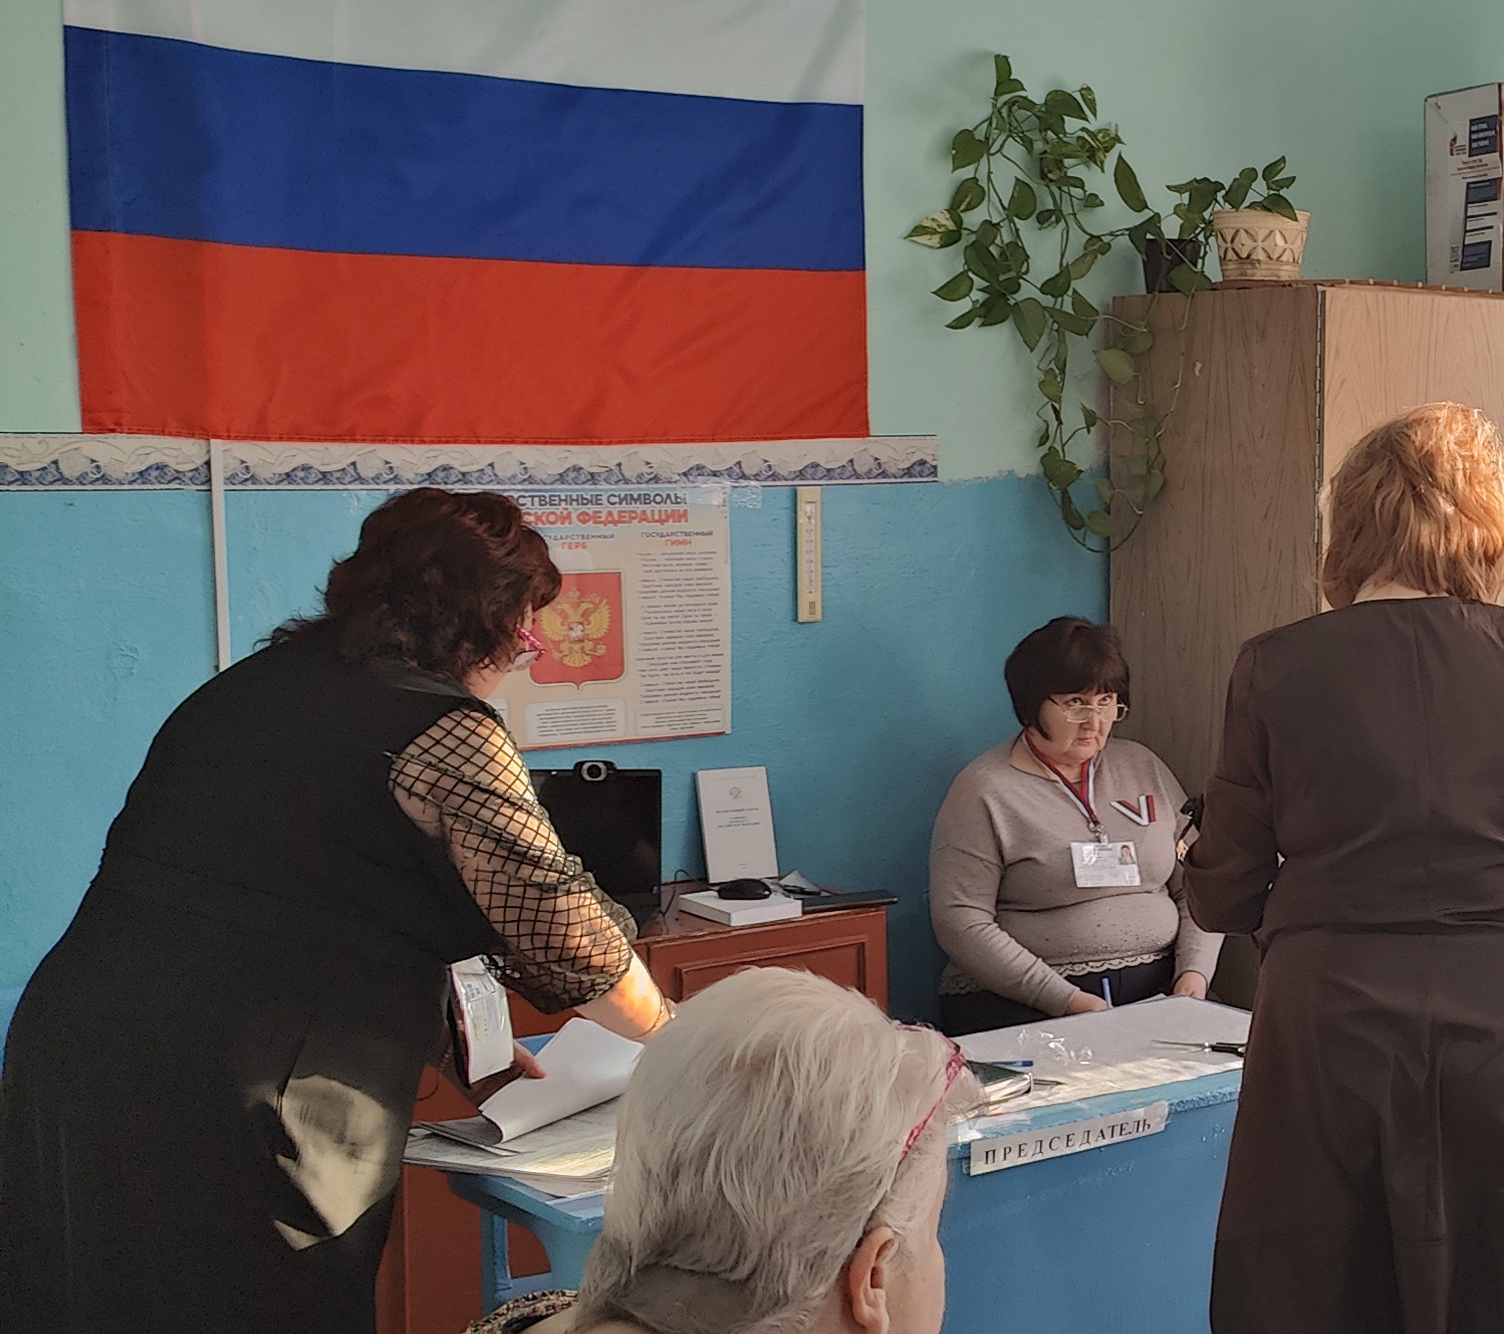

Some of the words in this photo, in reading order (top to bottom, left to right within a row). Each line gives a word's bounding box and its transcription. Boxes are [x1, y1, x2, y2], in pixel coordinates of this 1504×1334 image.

[606, 492, 688, 506] СИМВОЛЫ
[576, 508, 689, 527] ФЕДЕРАЦИИ
[640, 529, 714, 539] ГОСУДАРСТВЕННЫЙ
[561, 541, 588, 550] ГЕРБ
[665, 538, 692, 547] ГИМН
[984, 1117, 1152, 1165] ПРЕДСЕДАТЕЛЬ
